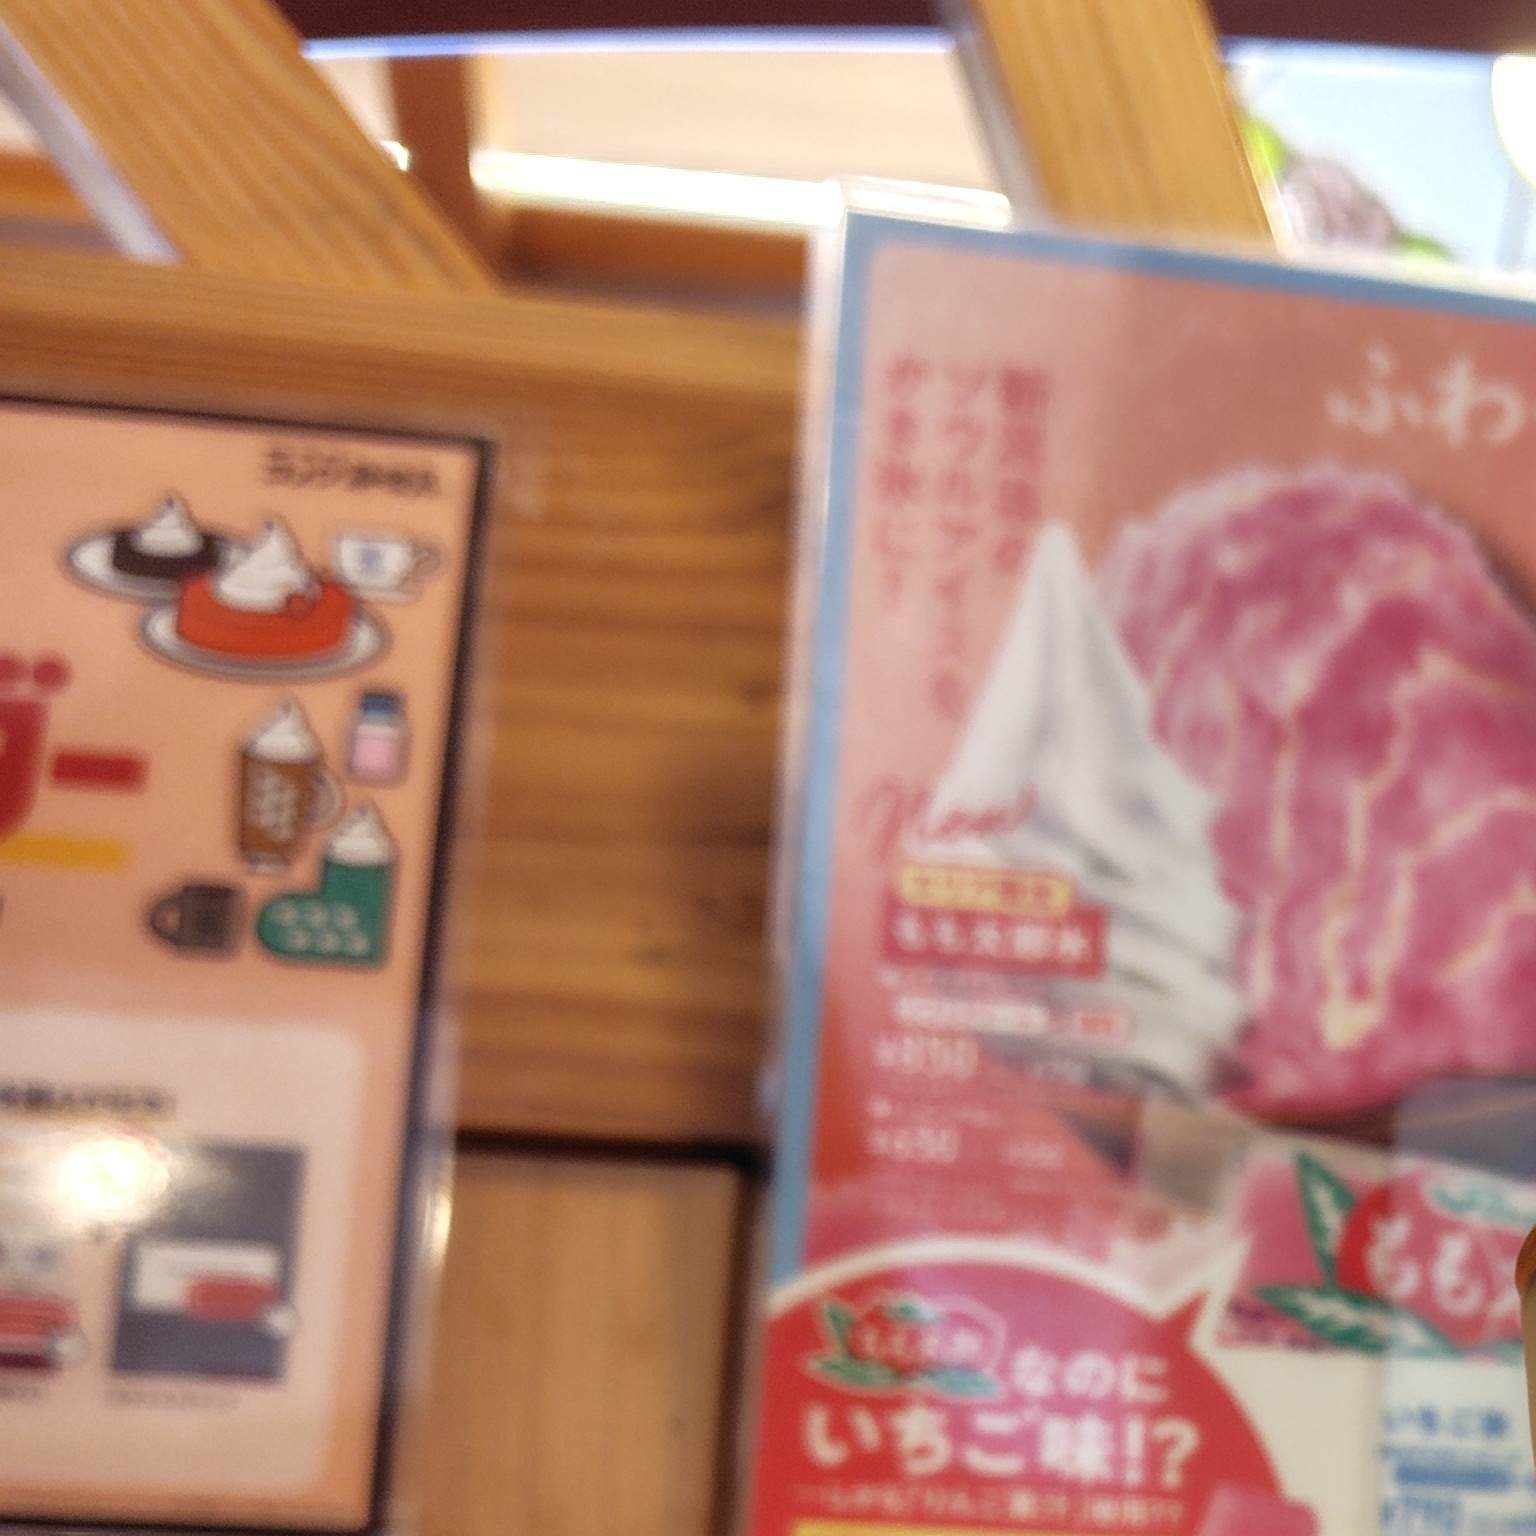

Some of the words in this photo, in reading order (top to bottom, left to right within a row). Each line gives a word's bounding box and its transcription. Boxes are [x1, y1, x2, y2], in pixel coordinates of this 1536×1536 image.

[1012, 1345, 1170, 1405] なのに
[801, 1400, 1200, 1490] いちご味!?
